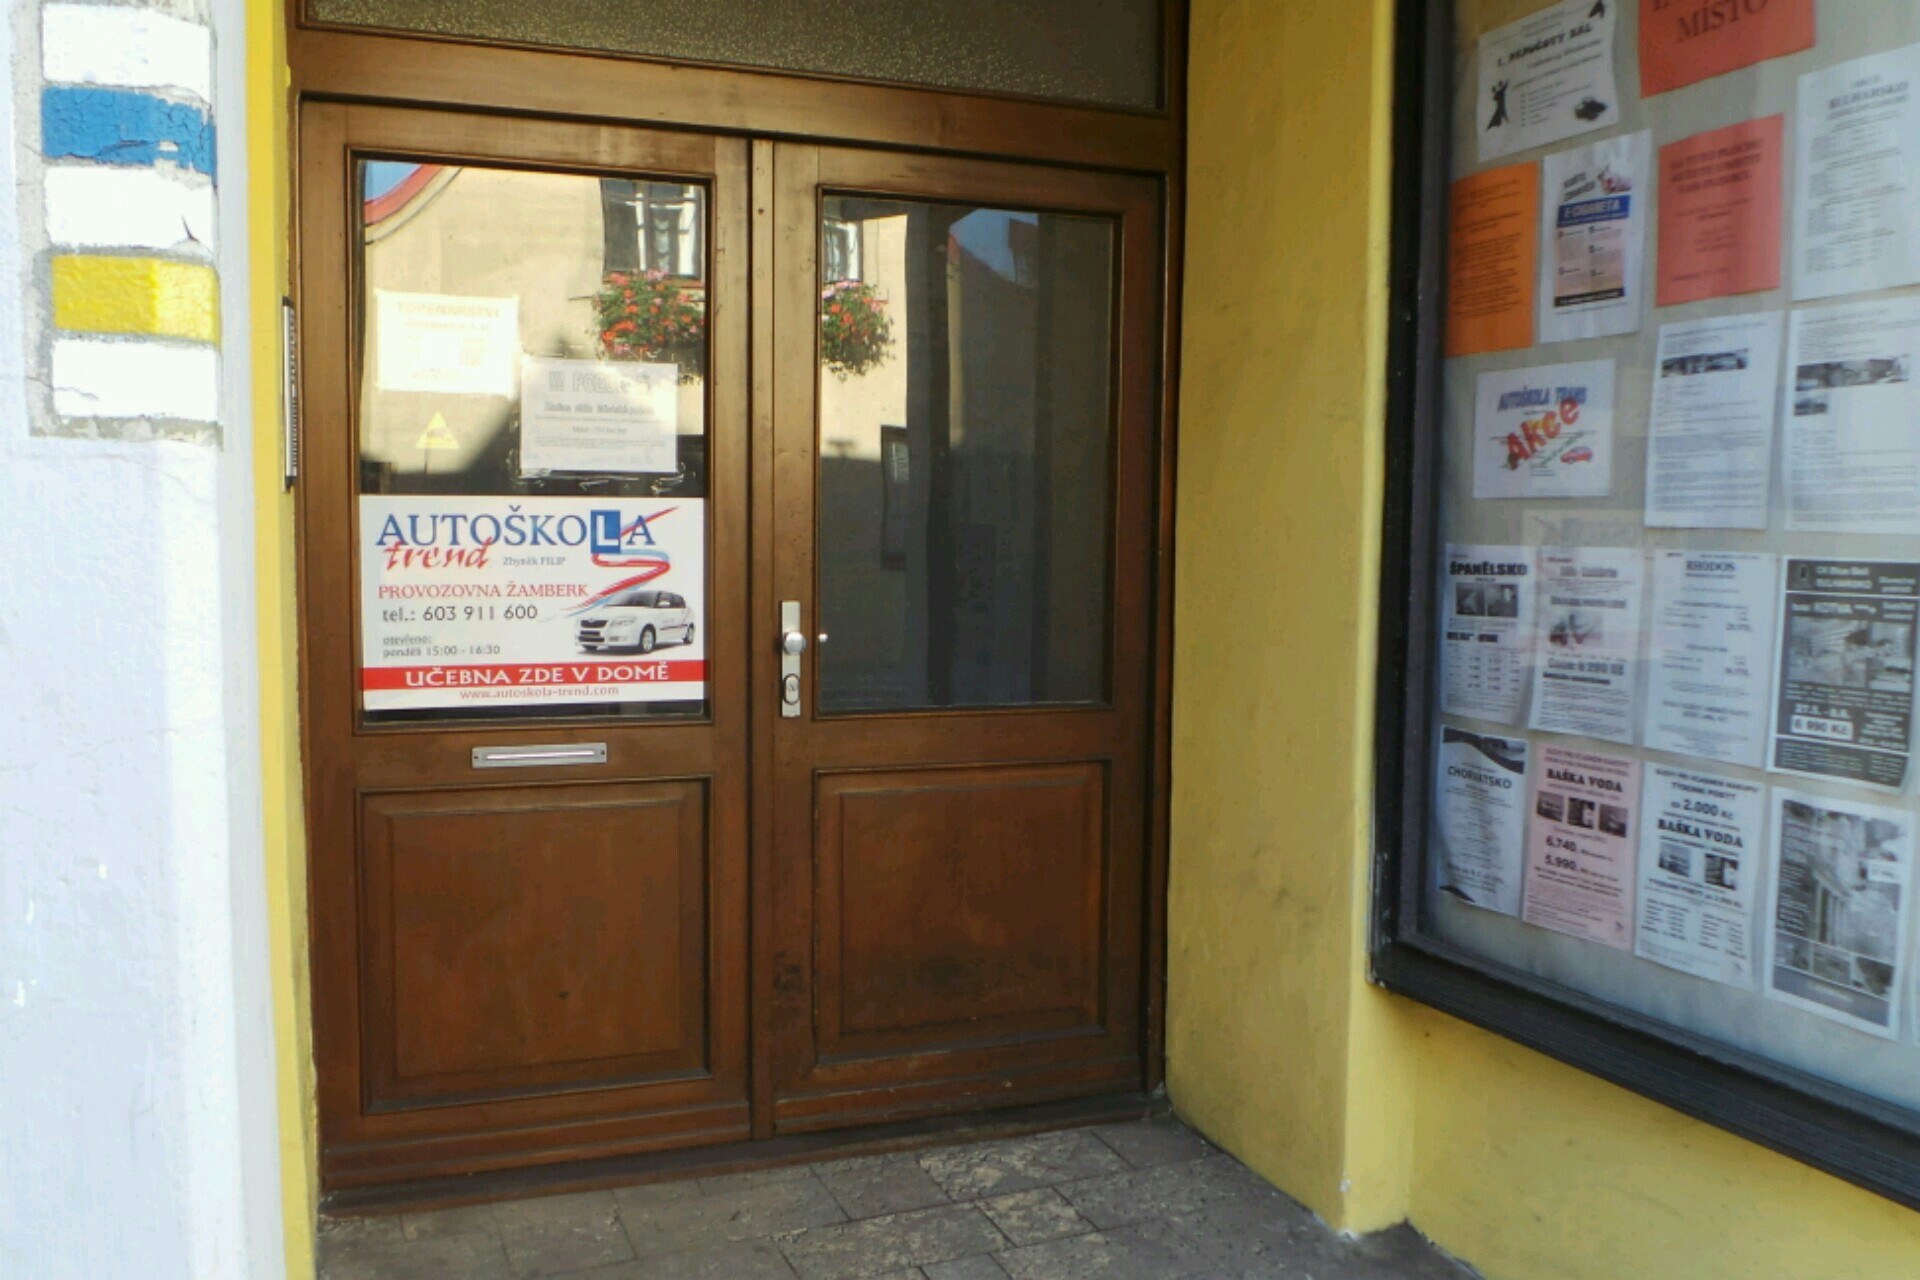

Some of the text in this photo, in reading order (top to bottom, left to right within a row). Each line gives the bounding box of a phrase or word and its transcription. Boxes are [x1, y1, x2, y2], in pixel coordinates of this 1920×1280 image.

[1676, 0, 1769, 42] MÍSTO
[376, 505, 657, 548] AUTOŠKOLA
[382, 537, 494, 571] trend
[539, 556, 567, 566] FILIP
[1449, 560, 1528, 576] ŠPANĚLSKO
[1685, 560, 1736, 573] RHODOS
[377, 580, 589, 600] PROVOZOVNA ŽAMBERK
[382, 604, 539, 622] tel.: 603 911 600
[426, 645, 458, 656] 15:00
[405, 660, 670, 688] UČEBNA ZDE V DOMĚ
[459, 685, 620, 701] www.autoskola-trend.com
[1546, 766, 1623, 793] BAŠKA VODA
[1683, 799, 1720, 817] 2.000
[1657, 818, 1743, 849] BAŠKA VODA
